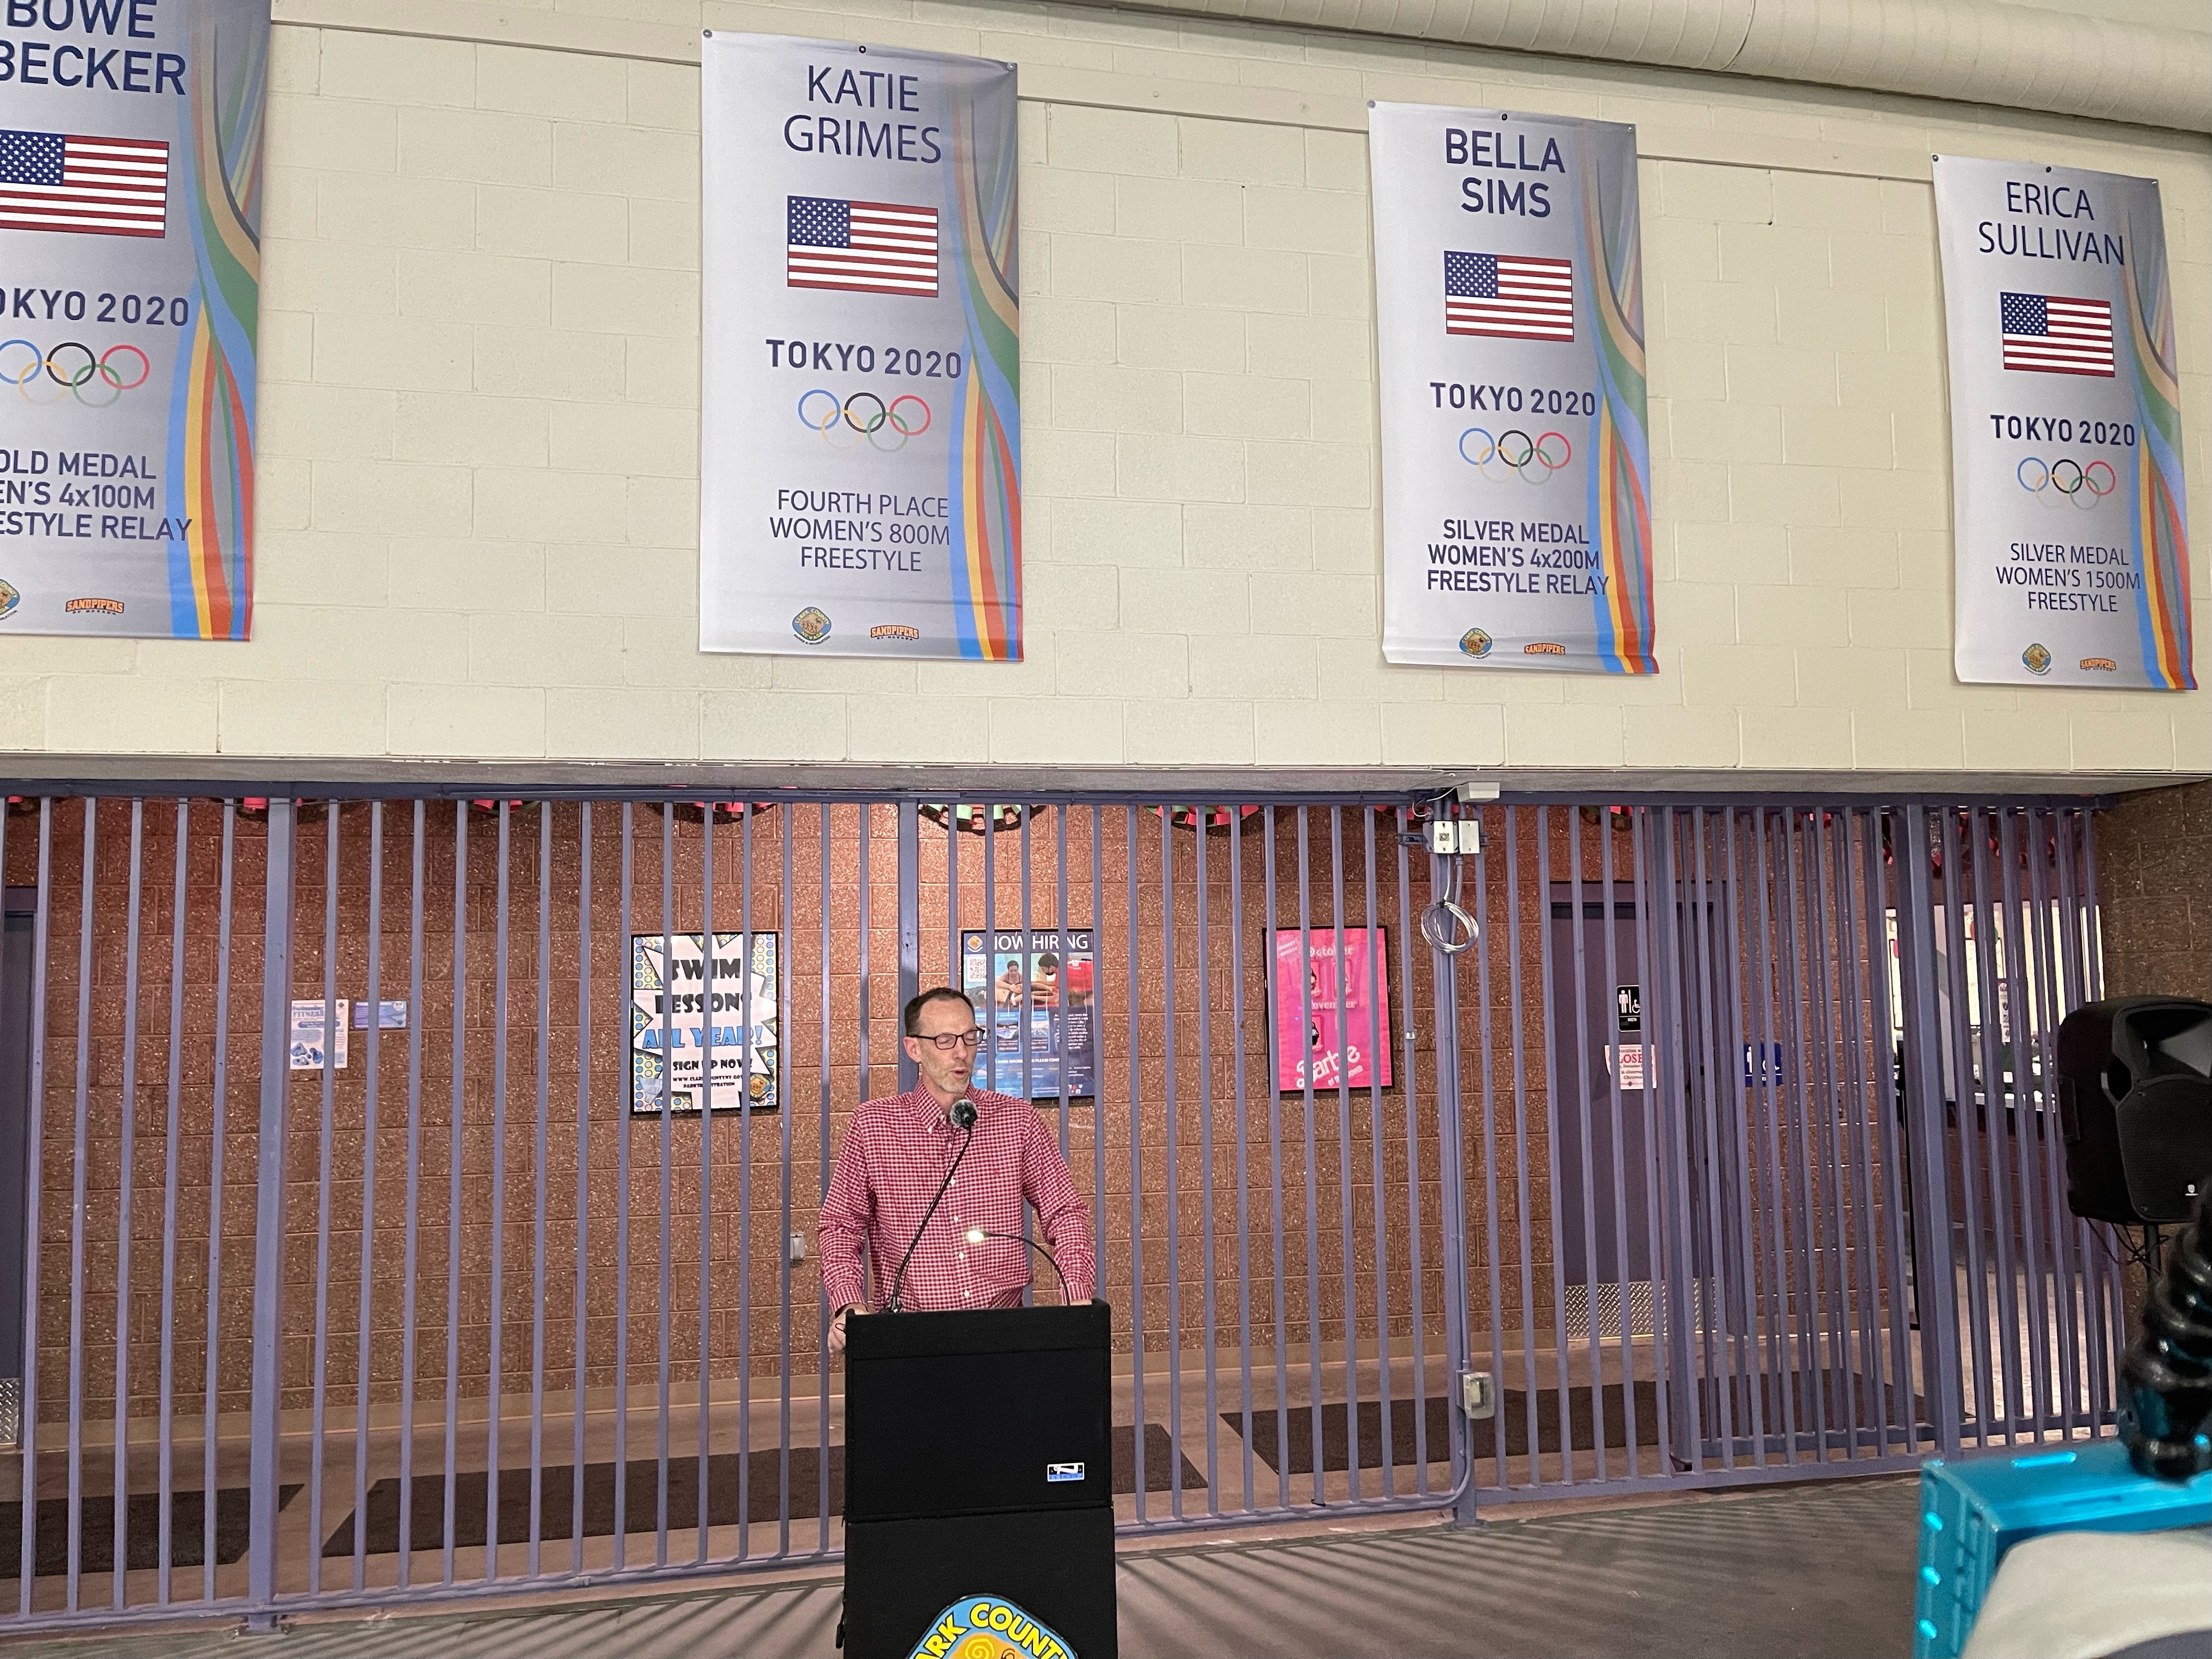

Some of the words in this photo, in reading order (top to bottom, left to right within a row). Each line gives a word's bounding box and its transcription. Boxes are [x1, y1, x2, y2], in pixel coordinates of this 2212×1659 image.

[7, 0, 157, 38] BOWE
[808, 65, 919, 112] KATIE
[784, 114, 941, 164] GRIMES
[1446, 128, 1566, 173] BELLA
[1461, 177, 1551, 218] SIMS
[2006, 181, 2095, 221] ERICA
[1978, 221, 2125, 266] SULLIVAN
[0, 287, 86, 321] KYO
[97, 293, 189, 326] 2020
[766, 338, 875, 373] TOKYO
[884, 348, 962, 379] 2020
[1430, 382, 1523, 413] TOKYO
[1531, 390, 1596, 416] 2020
[1990, 414, 2073, 442] TOKYO
[2079, 421, 2136, 447] 2020
[59, 452, 156, 480] MEDAL
[59, 483, 155, 510] 4x100M
[777, 489, 872, 514] FOURTH
[879, 494, 949, 518] PLACE
[101, 515, 193, 541] RELAY
[769, 517, 883, 542] WOMEN'S
[889, 524, 950, 545] 800M
[1443, 519, 1514, 541] SILVER
[1520, 523, 1590, 545] MEDAL
[800, 546, 922, 572] FREESTYLE
[1427, 544, 1525, 567] WOMEN'S
[1530, 549, 1600, 571] 4x200M
[2011, 543, 2066, 563] SILVER
[2070, 546, 2130, 566] MEDAL
[1427, 569, 1541, 594] FREESTYLE
[1547, 574, 1610, 596] RELAY
[1995, 566, 2081, 587] WOMEN'S
[2086, 570, 2141, 590] 1500M
[66, 599, 123, 613] SANDPIPERS
[2028, 591, 2118, 612] FREESTYLE
[794, 609, 810, 624] CLARK
[811, 608, 830, 624] COUNTY
[871, 625, 918, 640] SANDPIPERS
[1525, 644, 1565, 654] SANDPIPERS
[994, 935, 1023, 950] OW
[1032, 934, 1088, 950] HIRNG
[655, 992, 752, 1014] LESSON
[673, 1060, 699, 1070] SIGN
[969, 1602, 1069, 1659] COUNT
